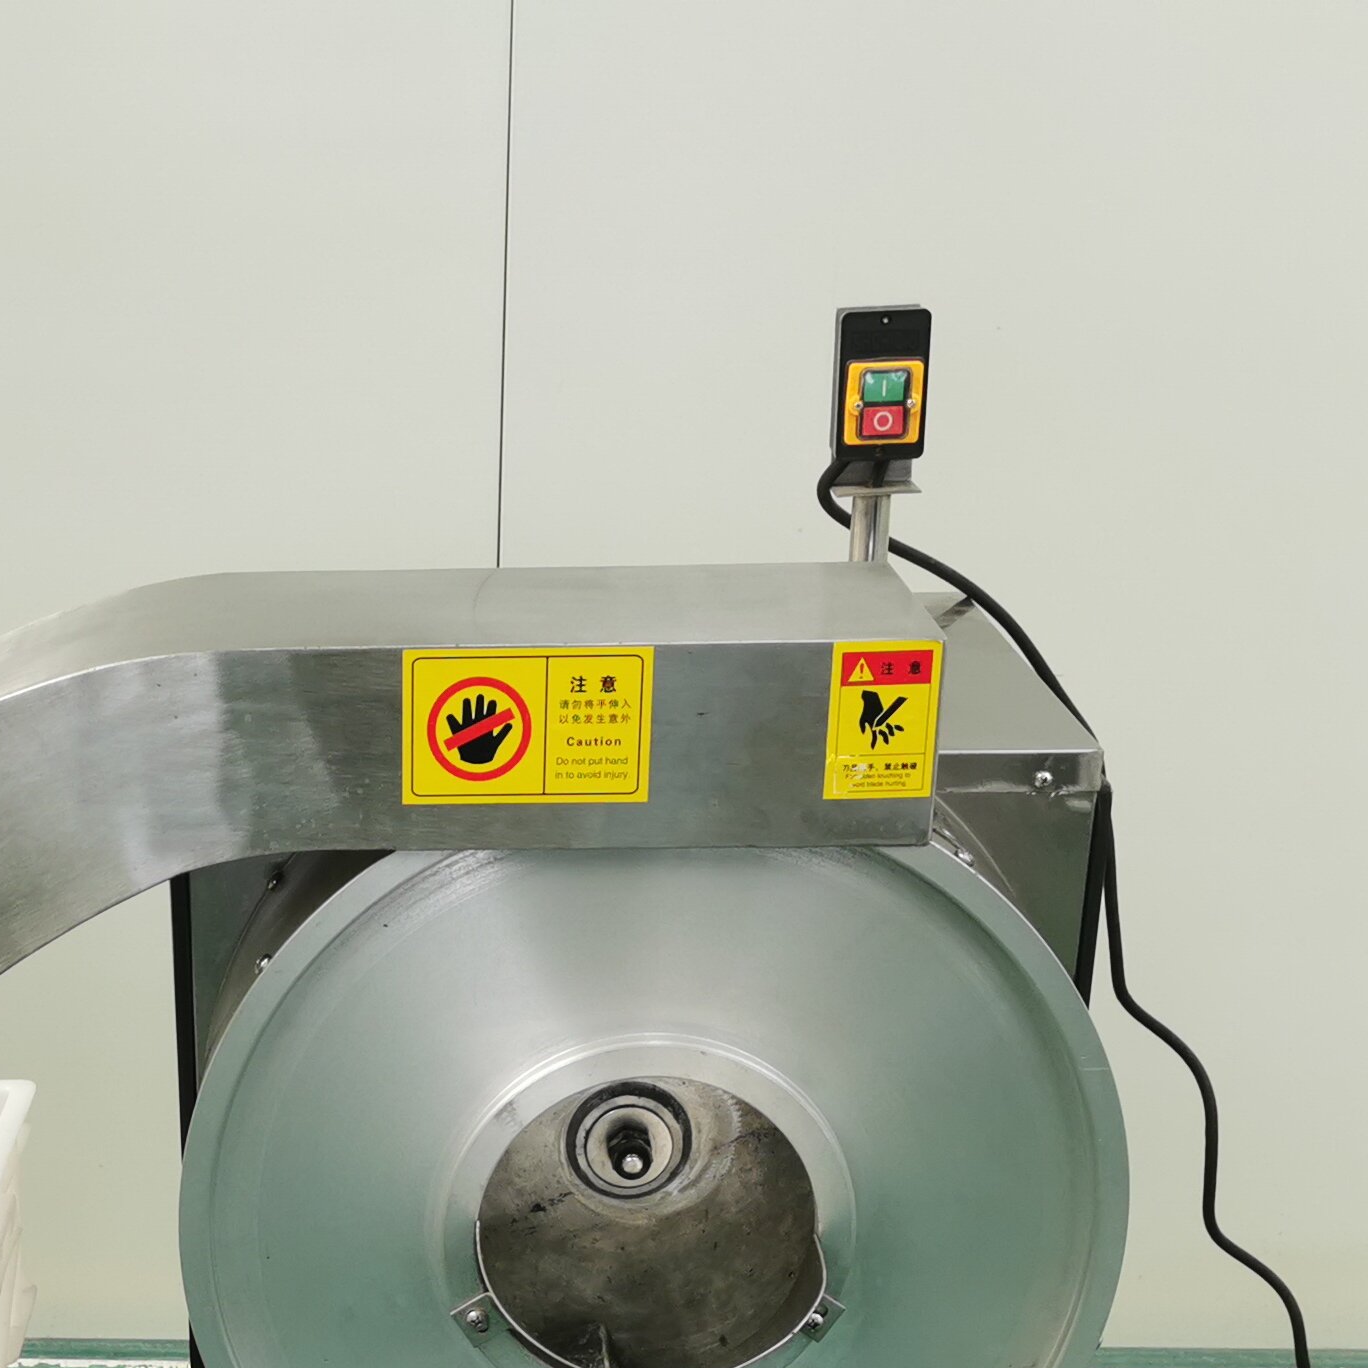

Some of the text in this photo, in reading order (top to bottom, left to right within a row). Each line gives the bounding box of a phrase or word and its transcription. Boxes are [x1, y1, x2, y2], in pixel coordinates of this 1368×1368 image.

[881, 661, 921, 675] 注意
[570, 675, 617, 693] 注意
[559, 713, 631, 725] 以免发生意外
[566, 736, 622, 747] Caution
[556, 756, 629, 767] Do not put hand
[566, 770, 575, 779] to
[576, 770, 601, 779] avoid
